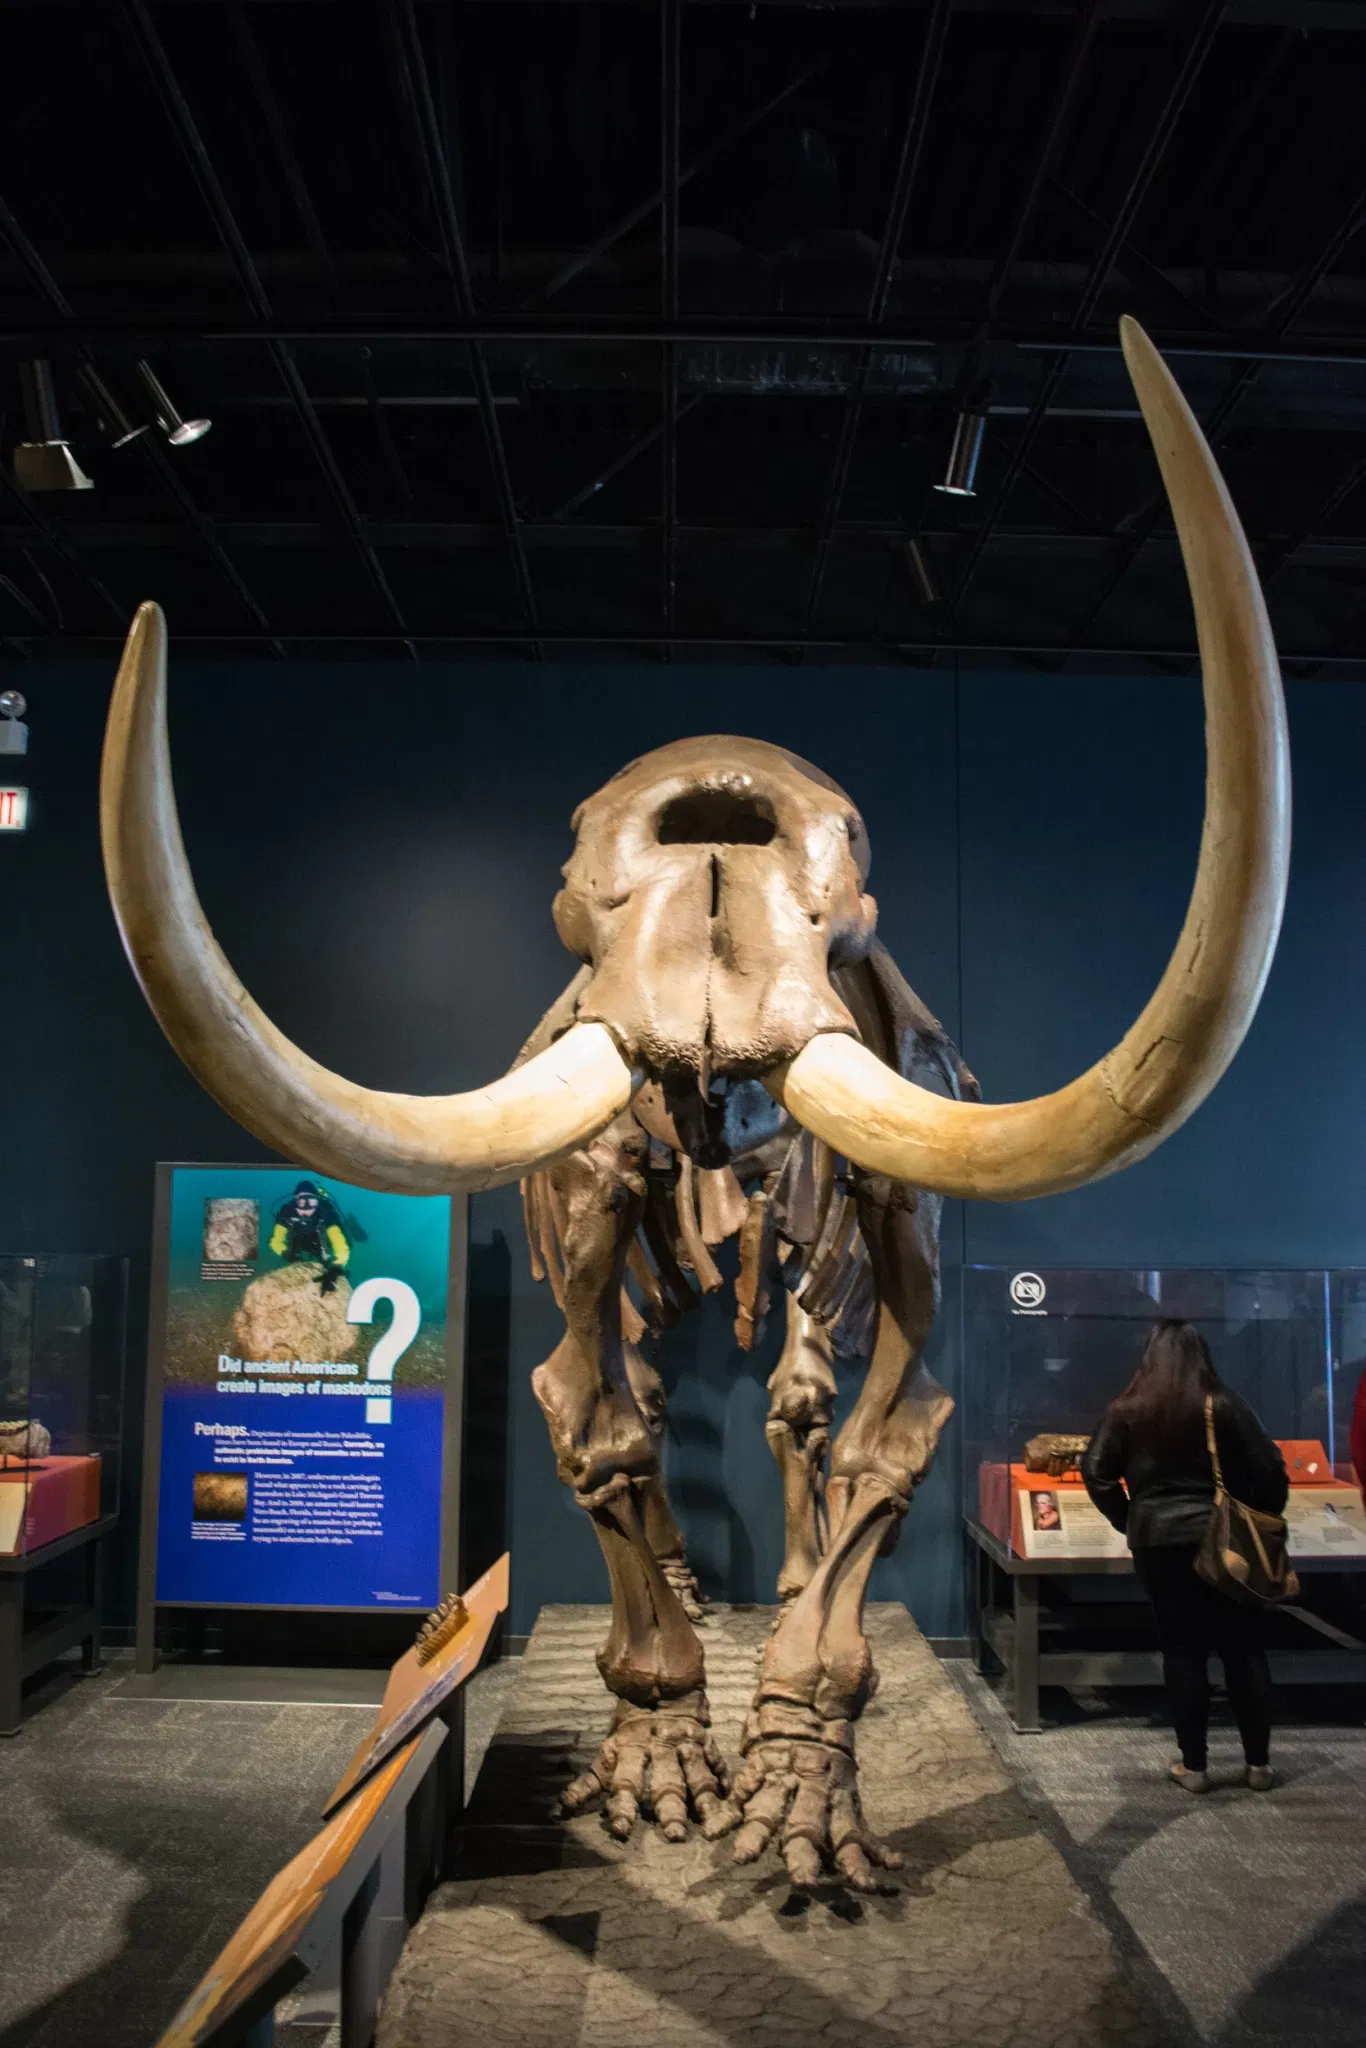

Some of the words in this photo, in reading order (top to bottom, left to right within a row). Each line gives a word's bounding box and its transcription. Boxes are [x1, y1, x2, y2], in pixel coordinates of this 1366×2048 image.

[346, 1276, 422, 1425] ?
[217, 1354, 242, 1373] Did
[243, 1360, 291, 1374] ancient
[291, 1360, 359, 1375] Americans
[216, 1379, 257, 1393] create
[258, 1379, 305, 1397] images
[306, 1380, 321, 1395] of
[322, 1381, 392, 1397] mastodons
[194, 1421, 250, 1440] Perhaps.
